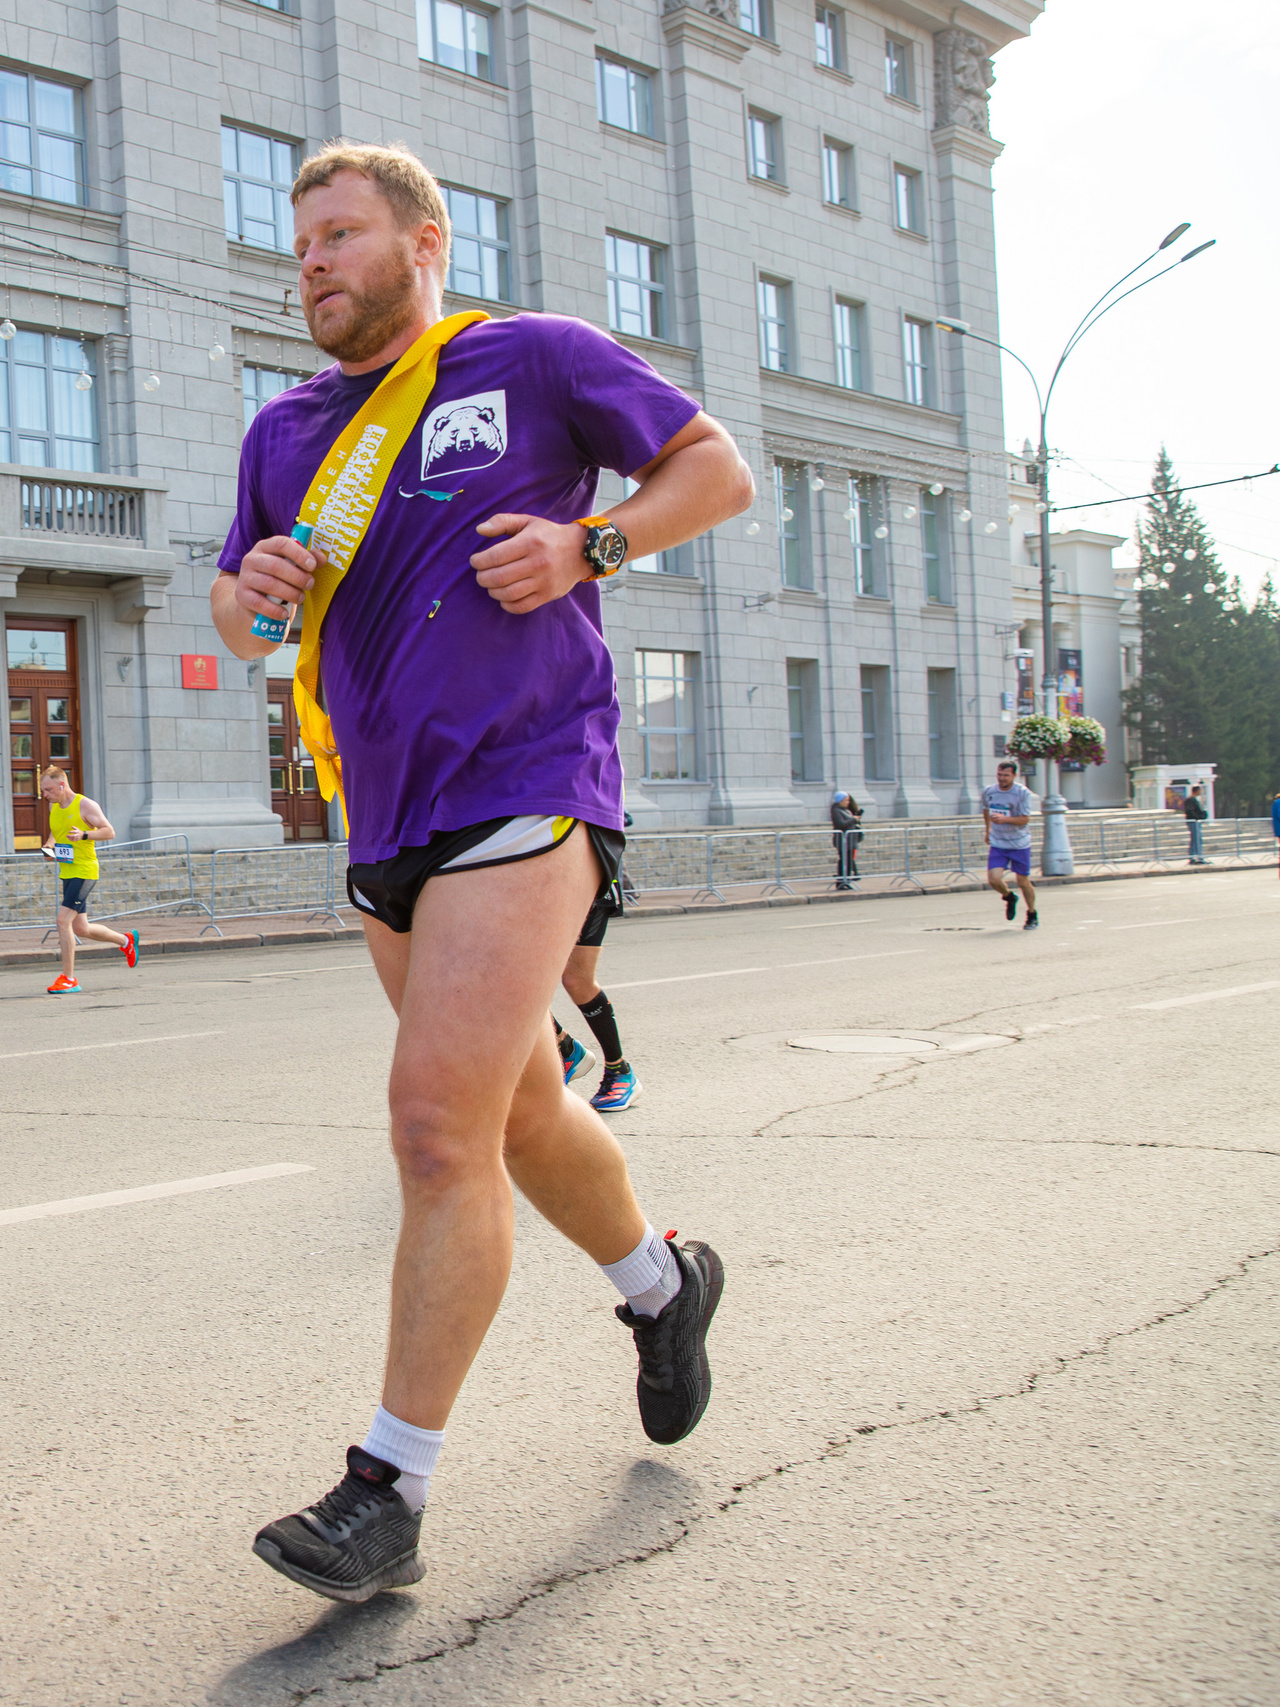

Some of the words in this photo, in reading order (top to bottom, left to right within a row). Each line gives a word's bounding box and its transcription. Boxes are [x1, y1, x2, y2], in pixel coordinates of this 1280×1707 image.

[316, 424, 375, 531] НОВОСИБИРСКИЙ
[321, 430, 384, 546] ПОЛУМАРАФОН
[332, 457, 381, 552] АЛЕКСАНДРА
[333, 493, 376, 571] РАЕВИЧА
[59, 848, 70, 856] 693
